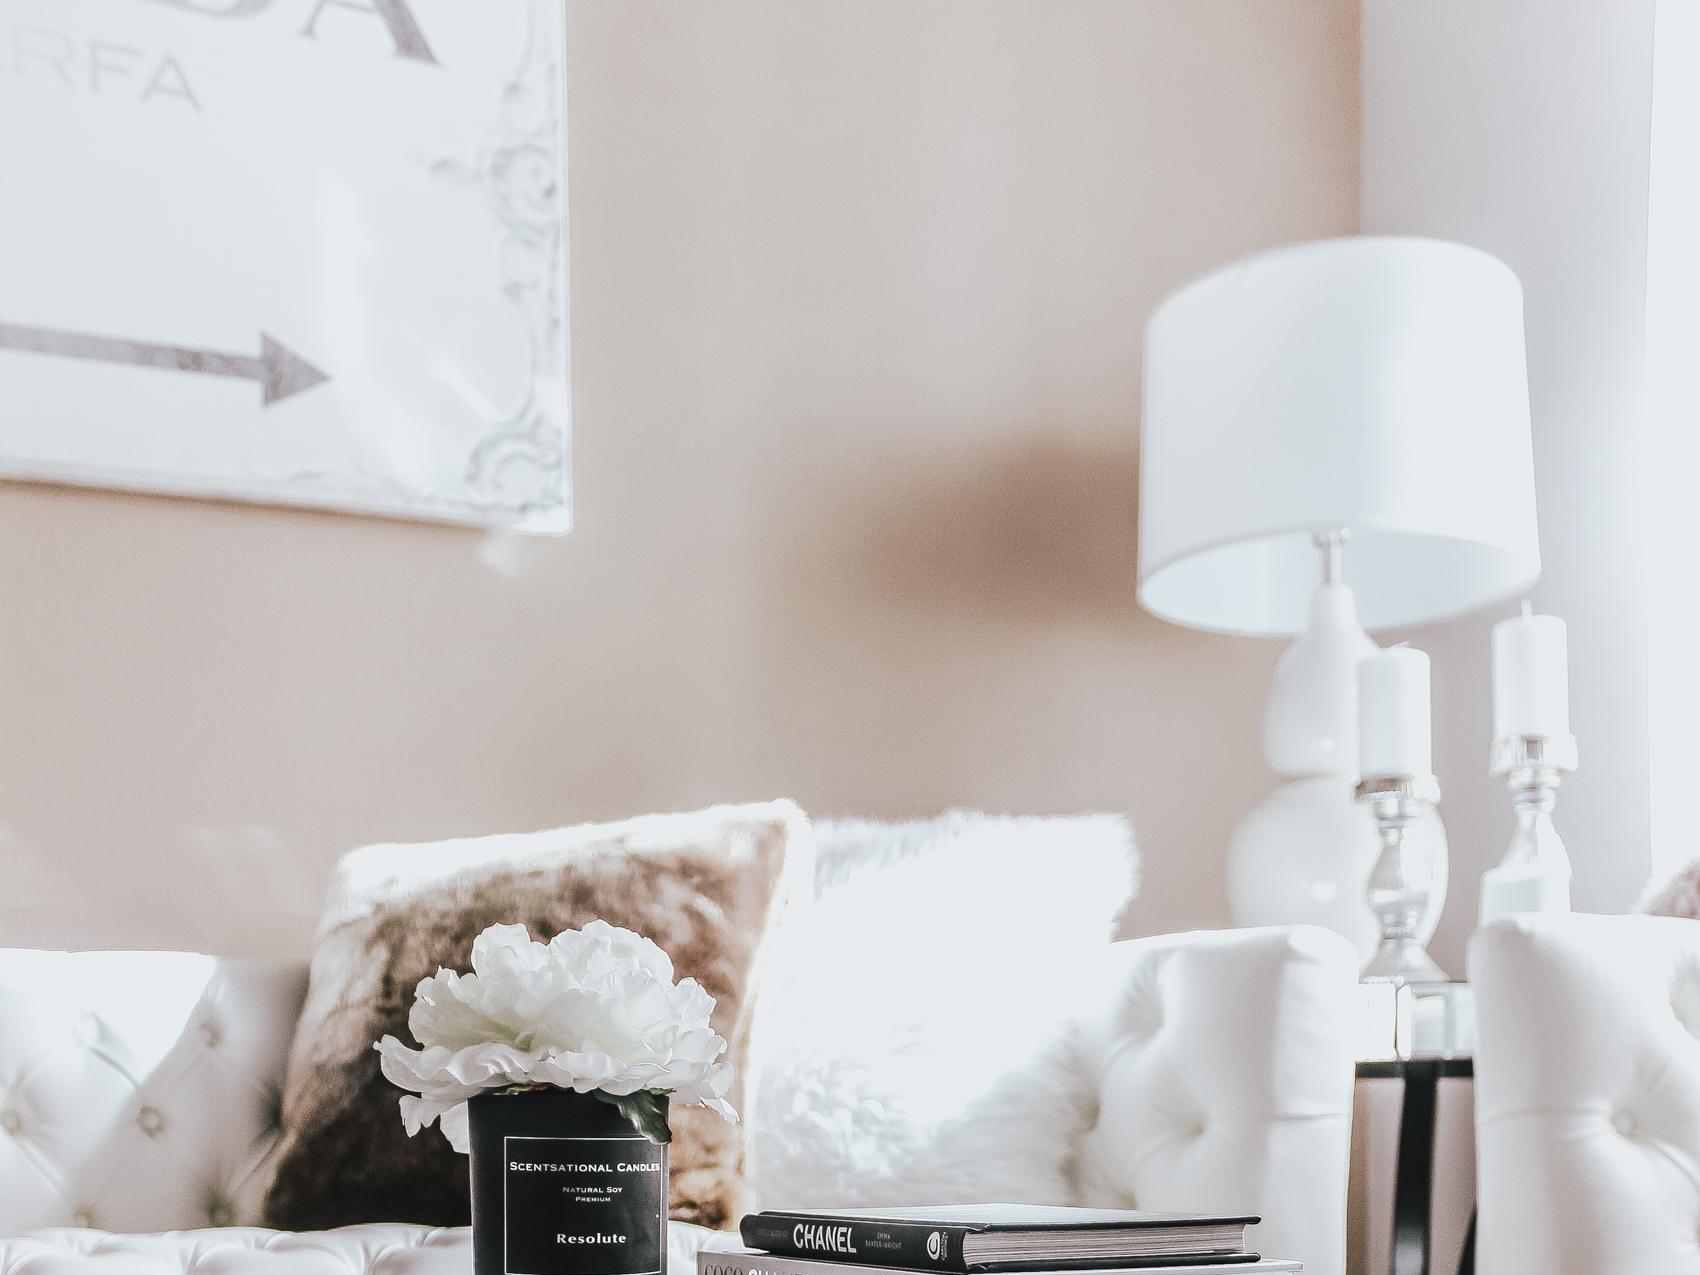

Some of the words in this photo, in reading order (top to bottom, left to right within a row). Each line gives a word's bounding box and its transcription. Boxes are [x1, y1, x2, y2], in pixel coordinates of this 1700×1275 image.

[0, 22, 204, 114] RFA
[509, 1161, 613, 1173] SCENTSATIONAL
[616, 1161, 660, 1173] CANDLES
[562, 1186, 604, 1194] NATURAL
[606, 1186, 623, 1194] SOY
[556, 1232, 627, 1245] Resolute
[793, 1223, 857, 1254] CHANEL
